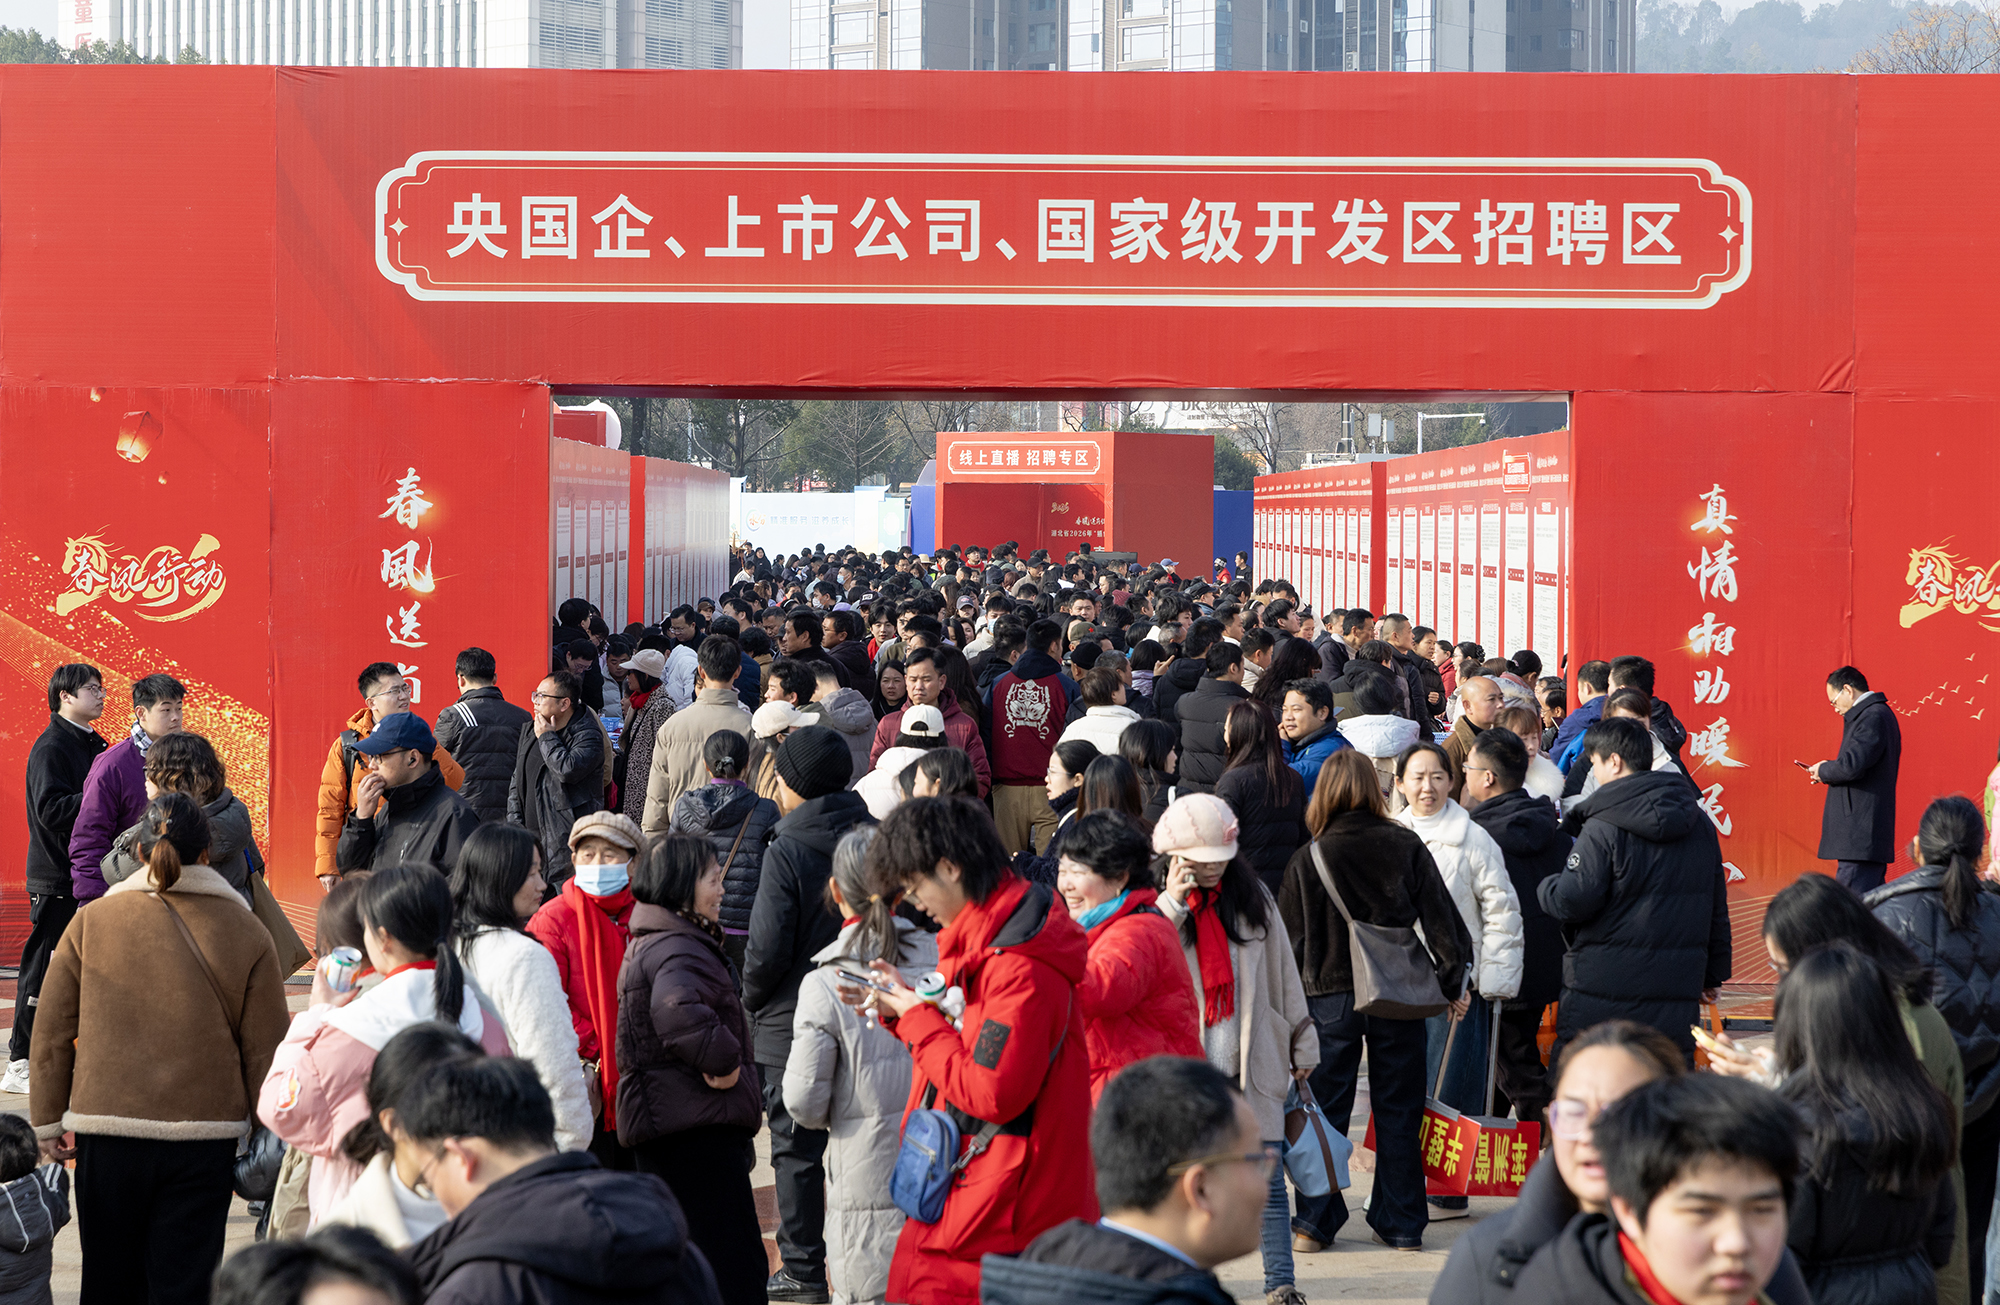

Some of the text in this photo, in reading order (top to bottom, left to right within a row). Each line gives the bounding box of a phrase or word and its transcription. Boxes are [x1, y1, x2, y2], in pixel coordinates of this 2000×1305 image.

[446, 193, 1683, 266] 央国企、上市公司、国家级开发区招聘区
[959, 449, 1089, 466] 线上直播 招聘专区
[65, 547, 224, 607] 春风行动
[1908, 558, 2000, 618] 春风
